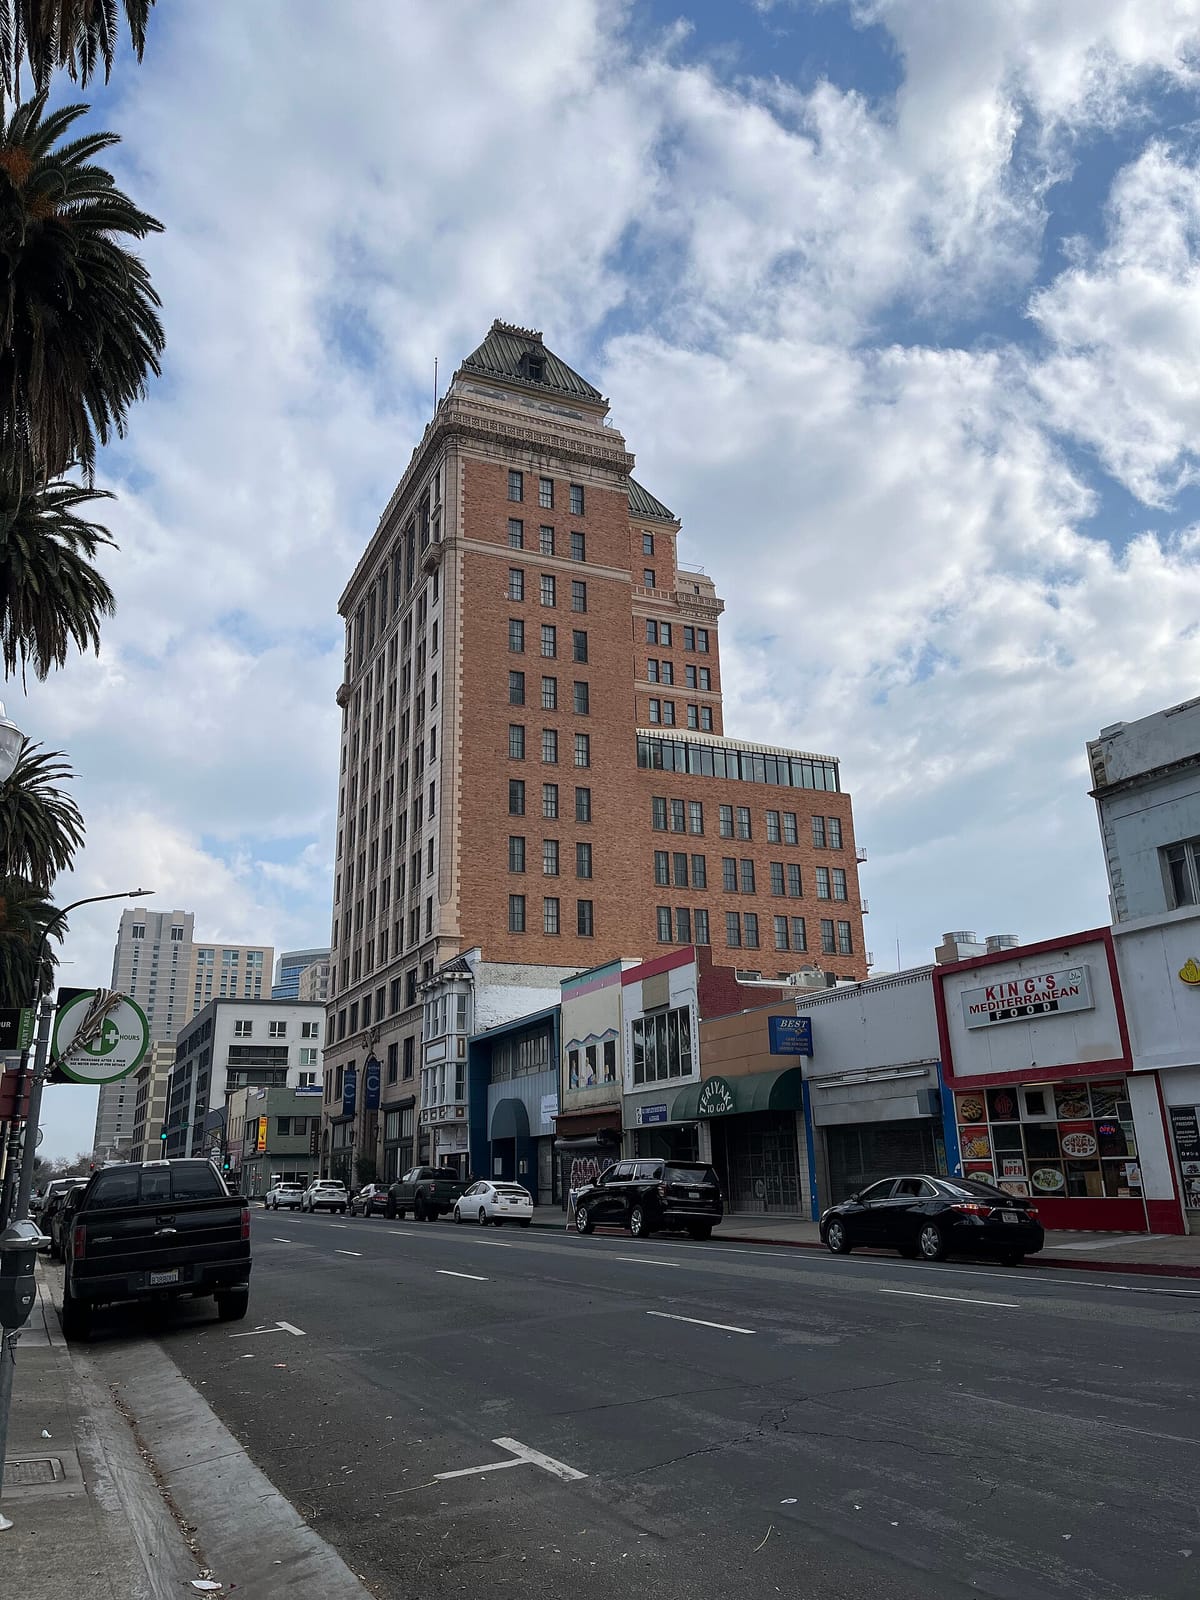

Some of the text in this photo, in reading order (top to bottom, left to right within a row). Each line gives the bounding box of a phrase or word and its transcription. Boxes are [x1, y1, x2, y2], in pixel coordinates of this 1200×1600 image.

[985, 975, 1056, 1001] KING'S
[969, 986, 1079, 1015] MEDITERRANEAN
[995, 1002, 1052, 1020] FOOD
[780, 1019, 808, 1028] BEST
[699, 1081, 733, 1113] TERIYAKI
[707, 1103, 725, 1113] TO GO
[1004, 1165, 1023, 1175] OPEN
